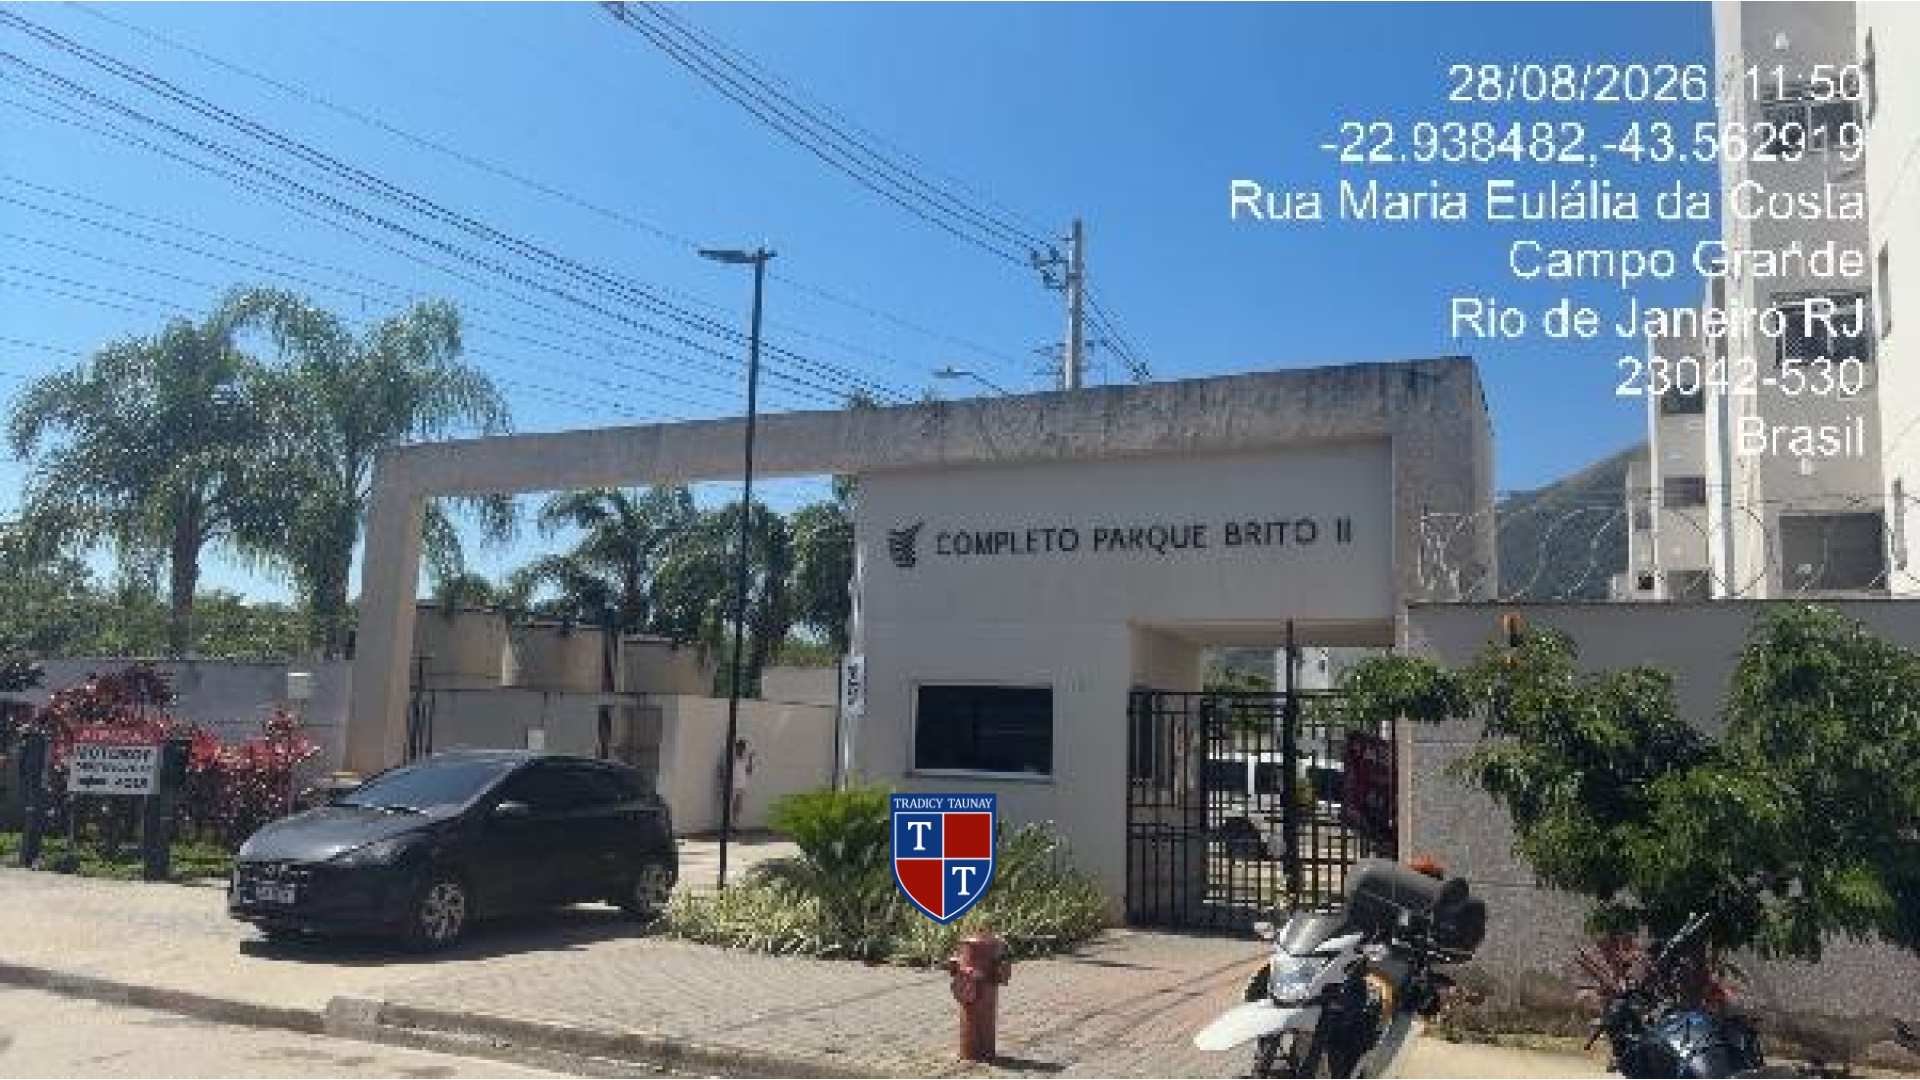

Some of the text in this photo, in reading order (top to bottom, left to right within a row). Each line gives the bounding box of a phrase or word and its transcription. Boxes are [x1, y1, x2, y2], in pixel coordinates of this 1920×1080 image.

[936, 517, 1352, 556] COMPLETO PARQUE BRITO II
